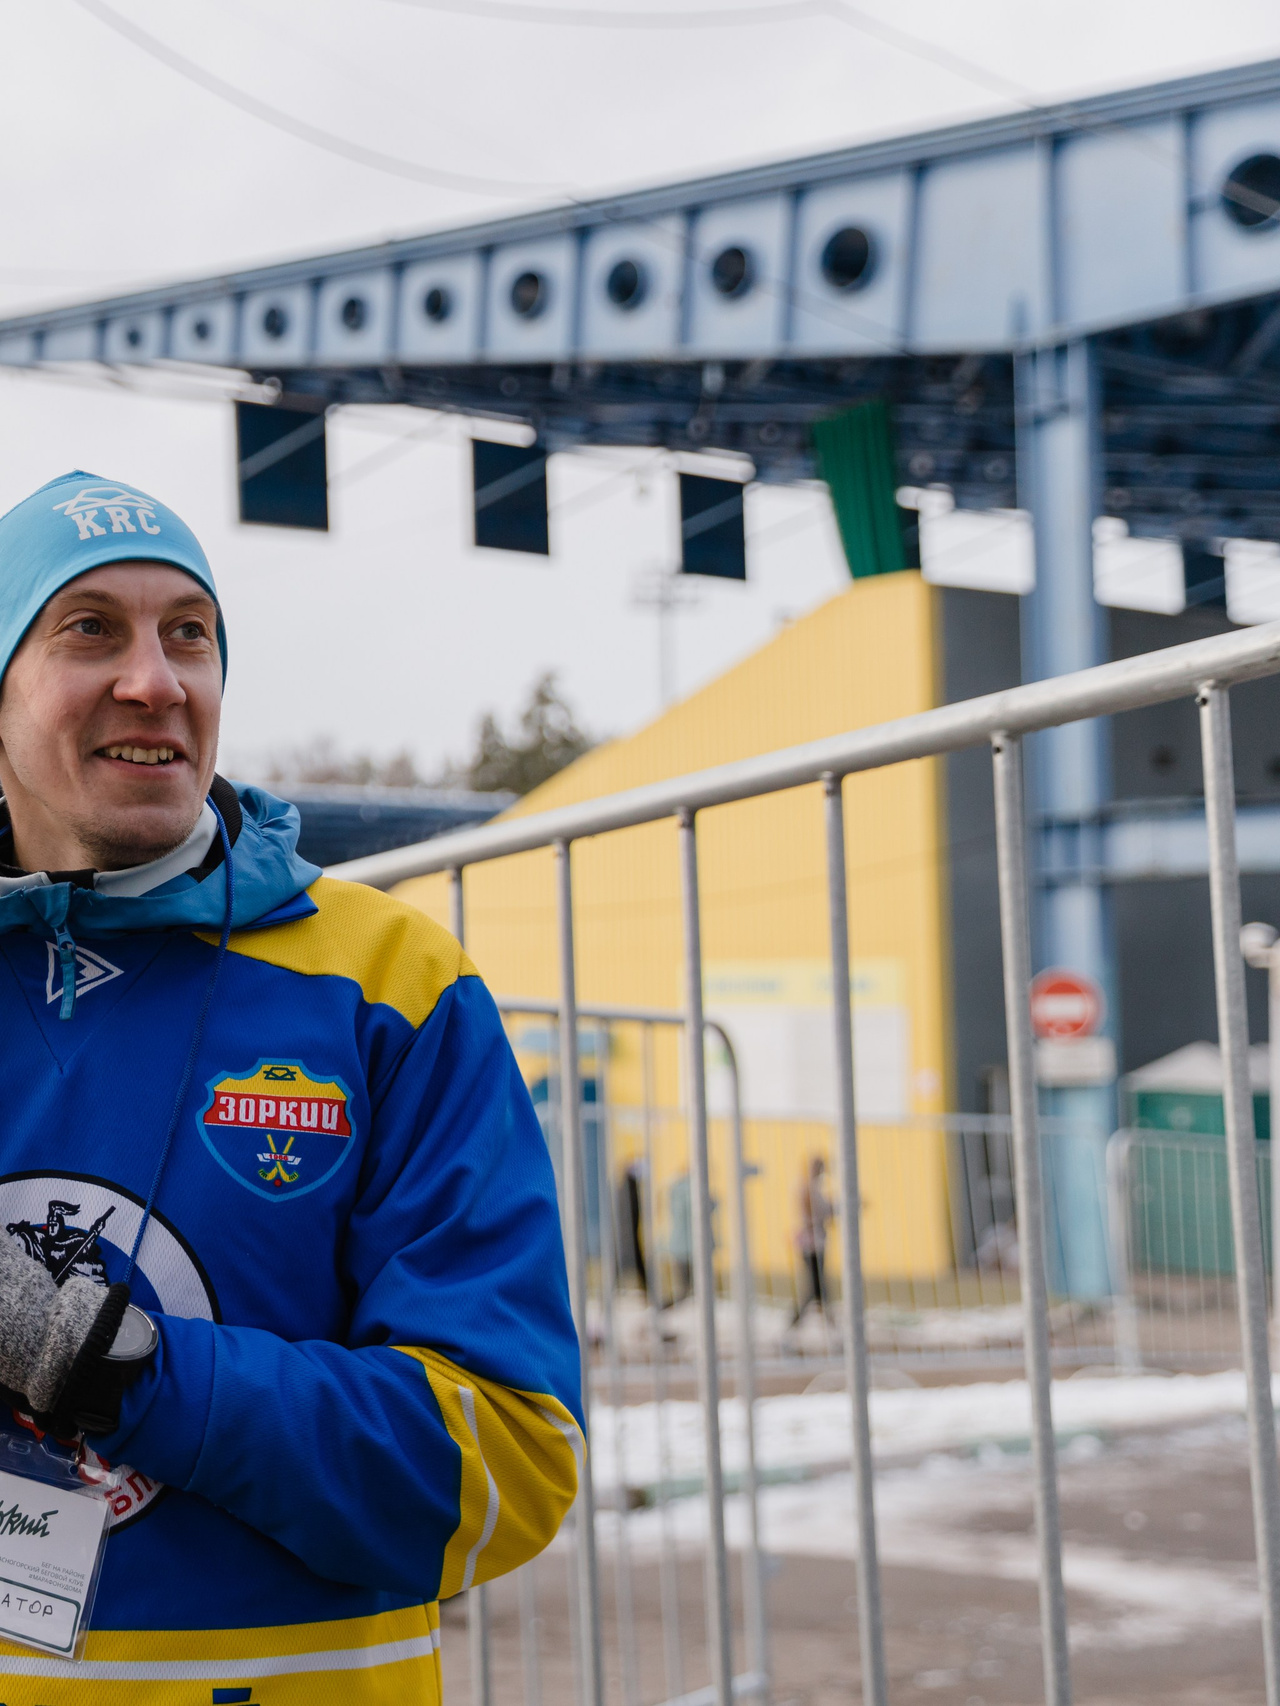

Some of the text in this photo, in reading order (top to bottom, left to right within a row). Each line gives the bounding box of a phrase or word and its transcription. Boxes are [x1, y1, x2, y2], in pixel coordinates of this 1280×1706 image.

[71, 506, 161, 541] KRC
[218, 1095, 339, 1131] ЗОРКИЙ
[41, 1561, 52, 1570] БЕГ
[62, 1567, 85, 1580] РАЙОНЕ
[41, 1570, 68, 1582] БЕГОВОЙ
[68, 1578, 84, 1587] КЛУБ
